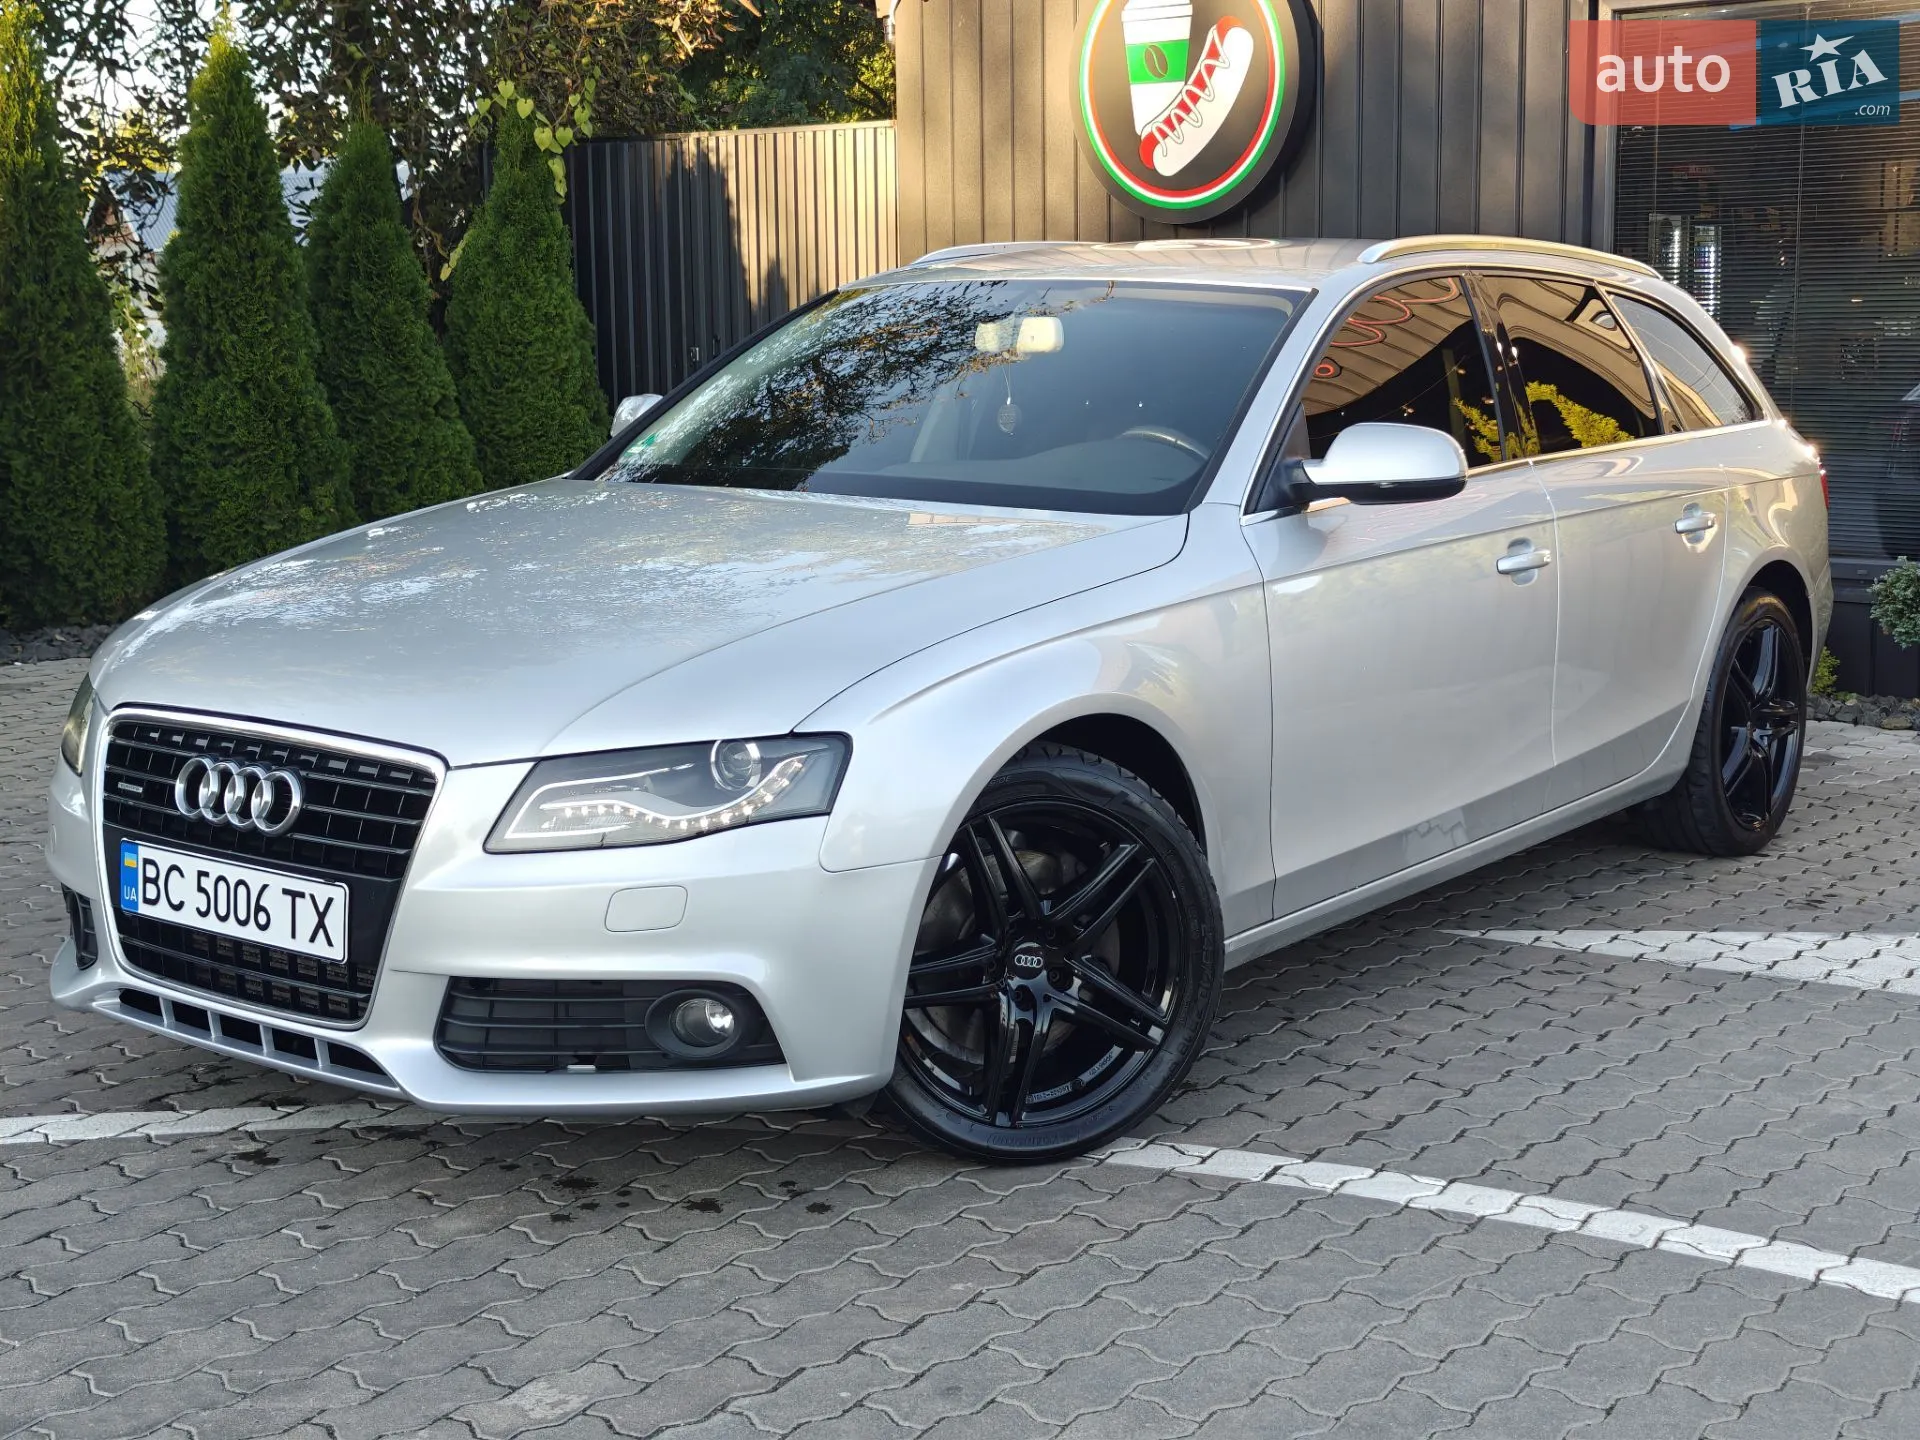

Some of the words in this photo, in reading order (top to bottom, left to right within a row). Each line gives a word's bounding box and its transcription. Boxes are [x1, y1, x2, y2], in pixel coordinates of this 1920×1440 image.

[124, 885, 137, 902] UA
[142, 857, 185, 912] BC
[195, 869, 271, 932] 5006
[281, 887, 335, 948] TX
